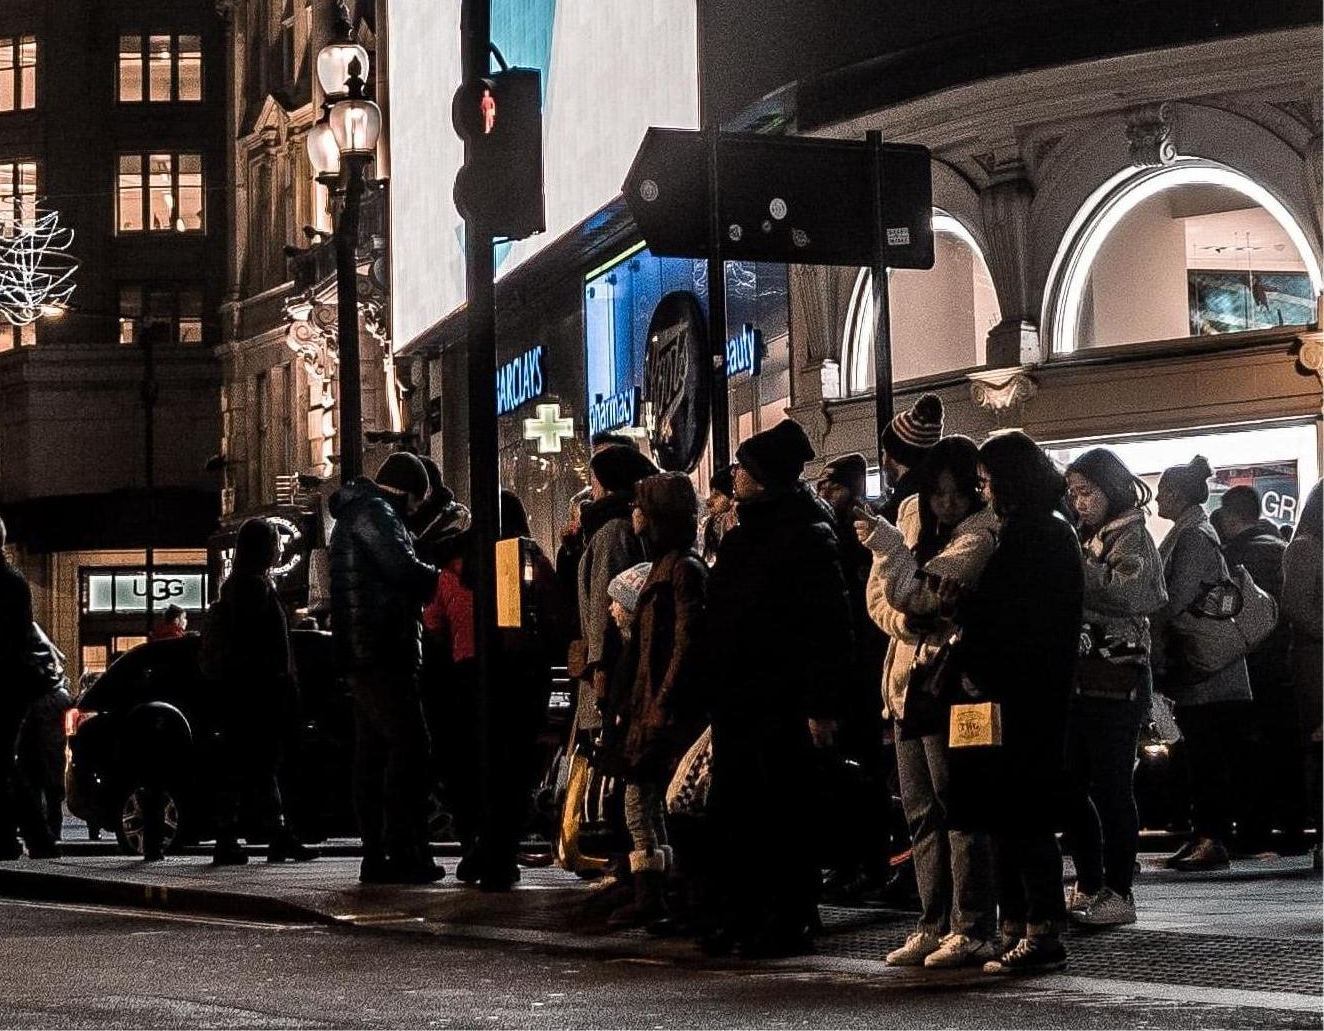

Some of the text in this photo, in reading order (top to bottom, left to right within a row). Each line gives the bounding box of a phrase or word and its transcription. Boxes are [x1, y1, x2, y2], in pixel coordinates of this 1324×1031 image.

[496, 345, 543, 415] ARCLAYS
[589, 386, 635, 437] pharmacy
[133, 578, 184, 601] UGG
